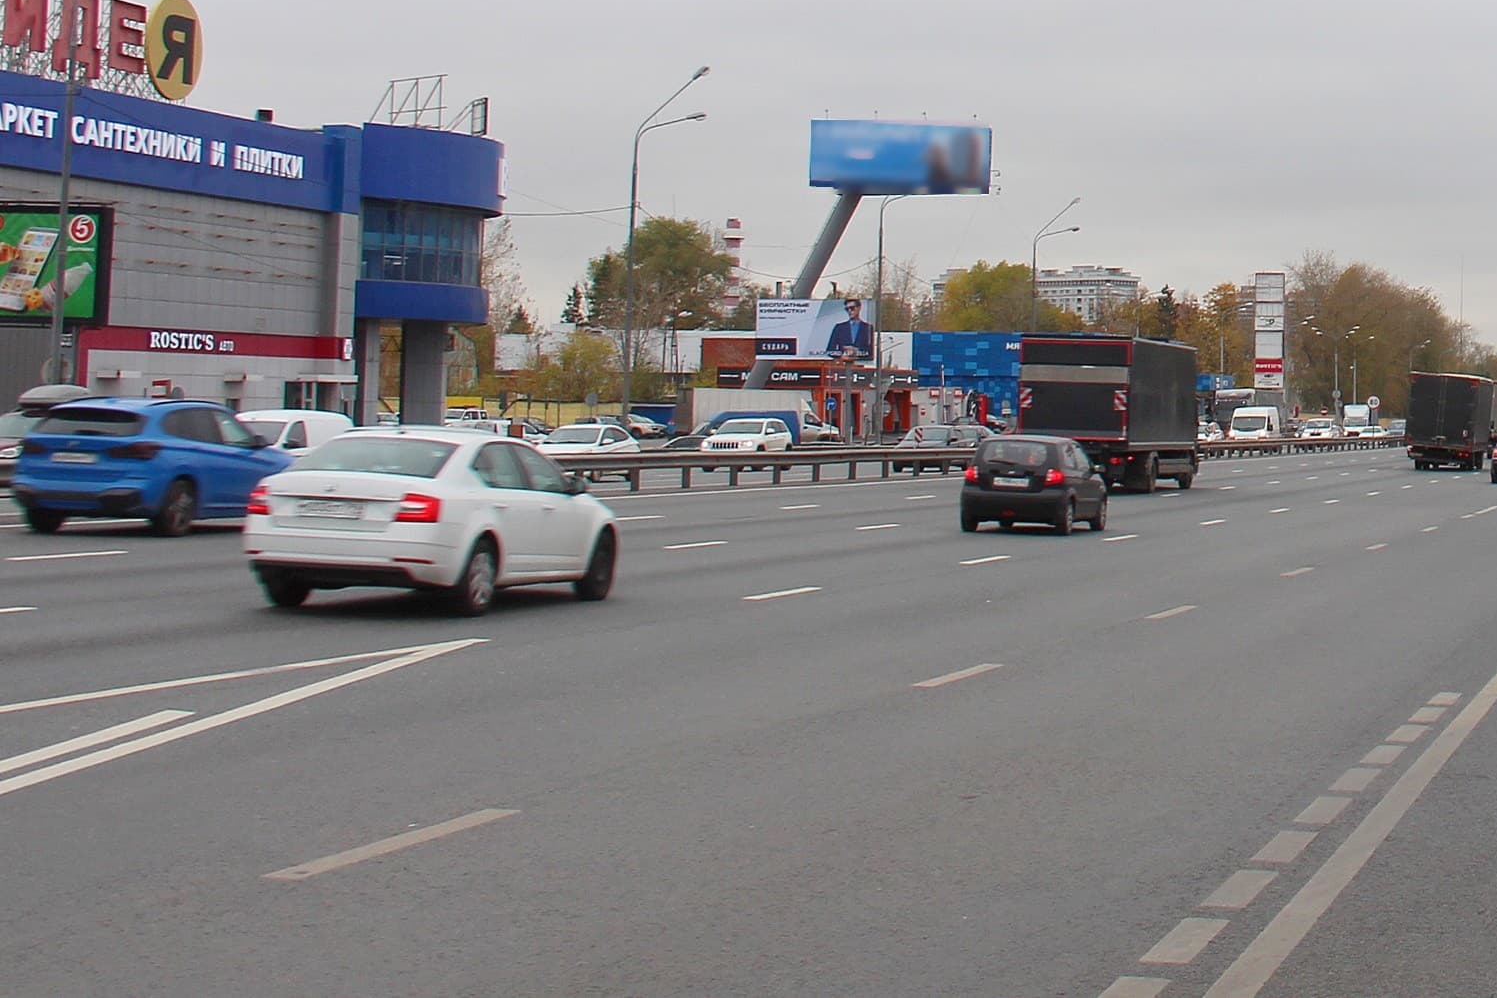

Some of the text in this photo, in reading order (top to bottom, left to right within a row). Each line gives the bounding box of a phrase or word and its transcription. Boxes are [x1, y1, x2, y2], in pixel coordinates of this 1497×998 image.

[71, 115, 202, 164] САНТЕХНИКИ
[210, 140, 227, 168] И
[234, 144, 304, 180] ПЛИТКИ
[150, 330, 215, 352] ROSTIC'S
[771, 372, 799, 382] САМ
